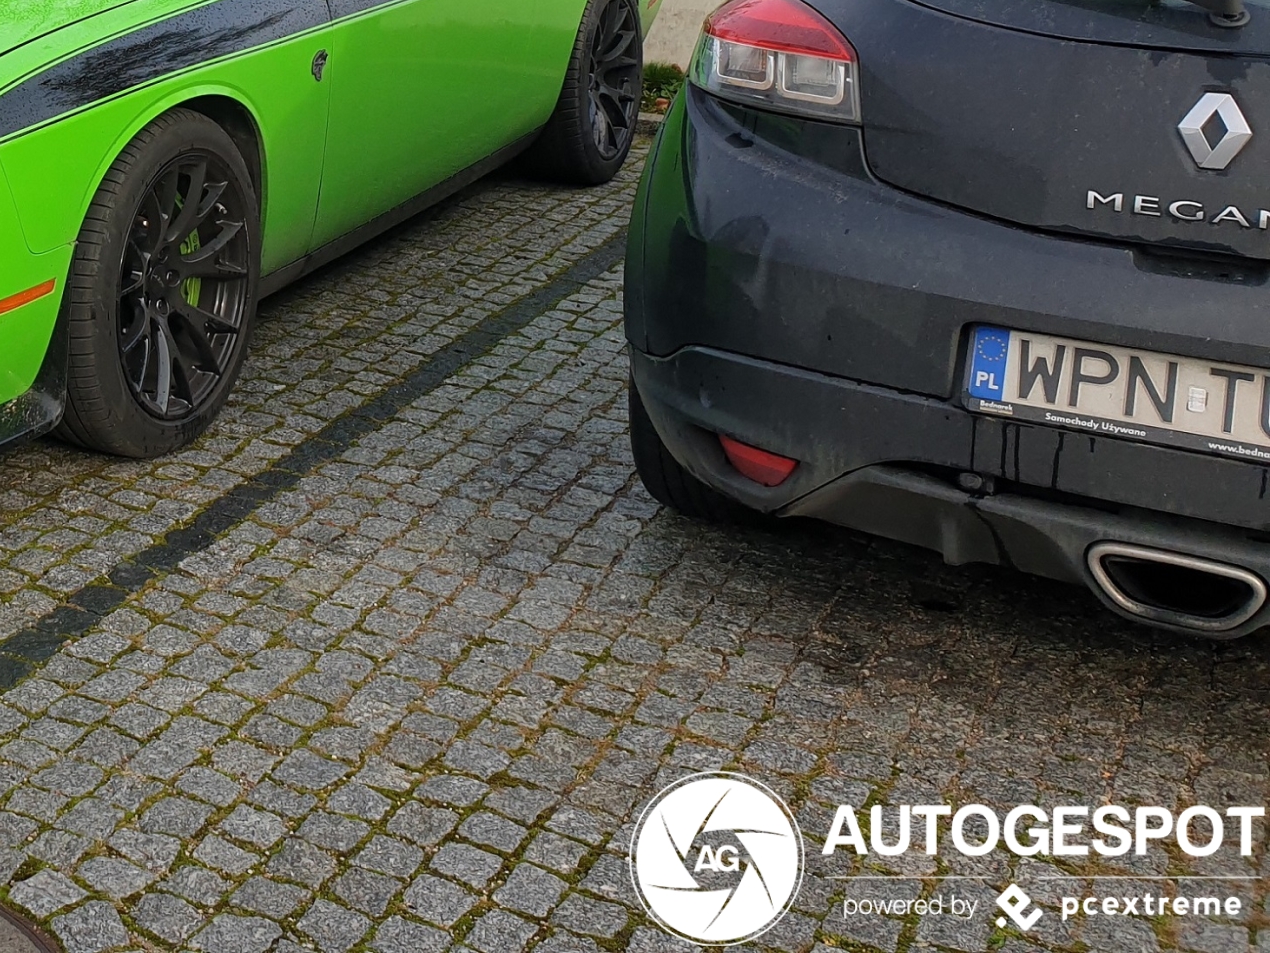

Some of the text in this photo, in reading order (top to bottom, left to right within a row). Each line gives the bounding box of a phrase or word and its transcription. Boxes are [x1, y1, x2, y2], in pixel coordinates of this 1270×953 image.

[975, 371, 999, 390] PL
[1017, 339, 1270, 439] WPN T
[980, 399, 1013, 412] Bednarek
[1045, 412, 1147, 437] Samochody Używane
